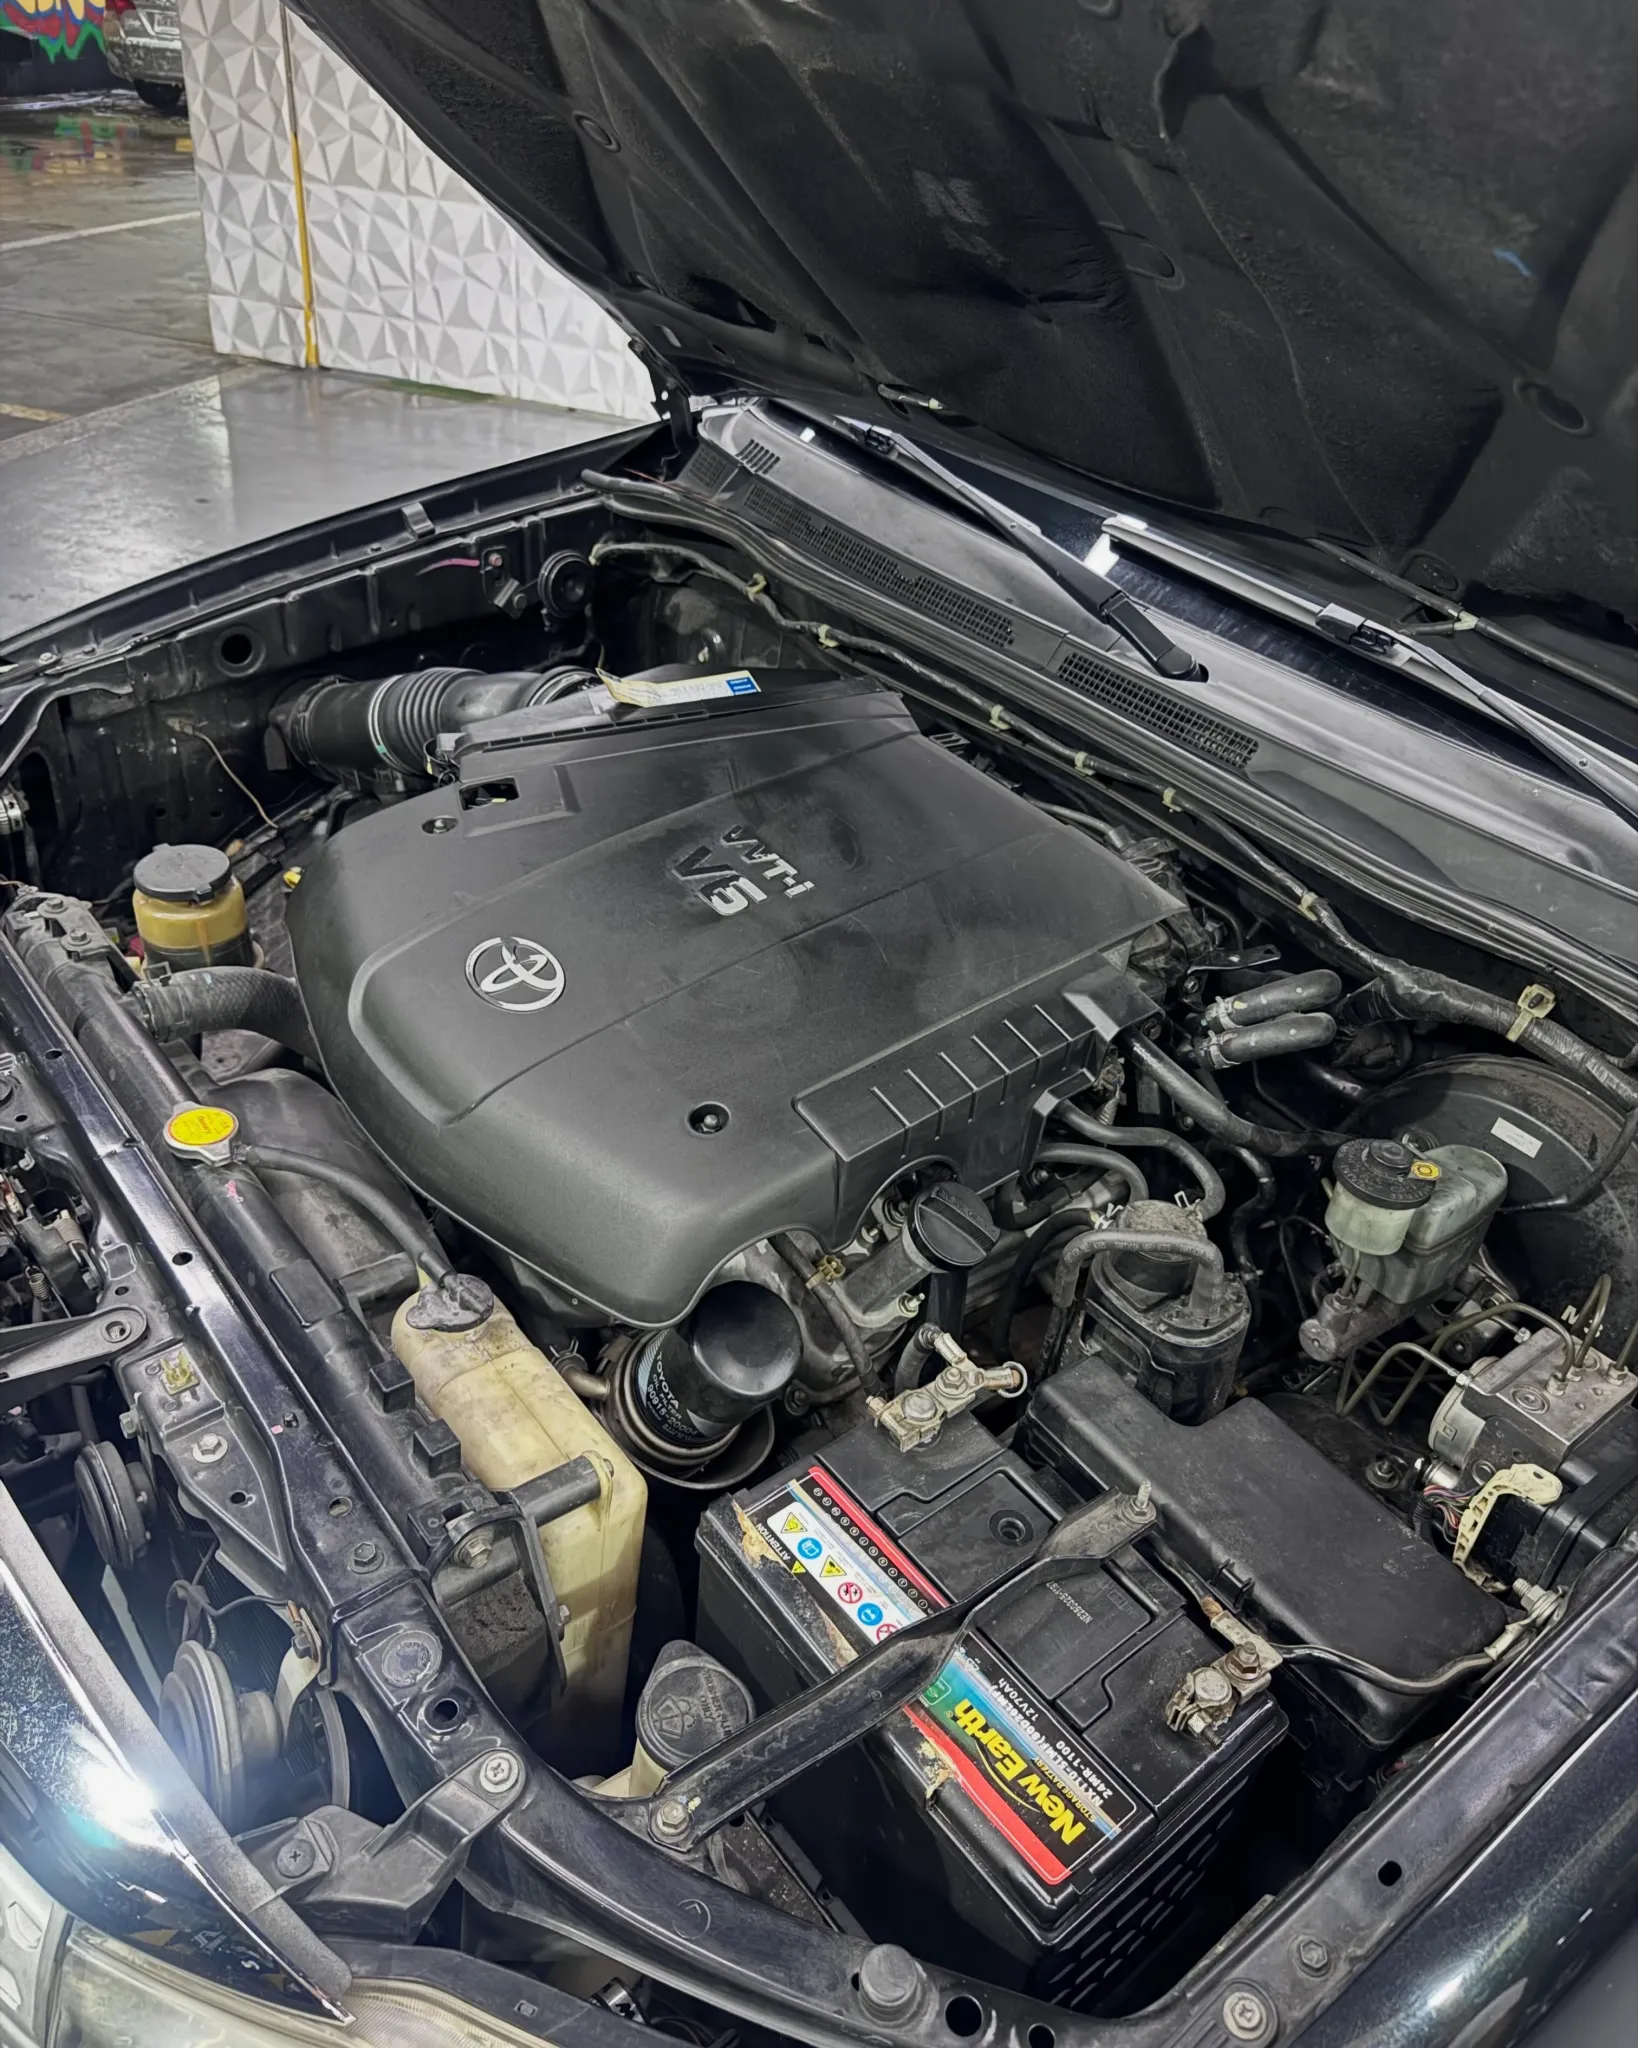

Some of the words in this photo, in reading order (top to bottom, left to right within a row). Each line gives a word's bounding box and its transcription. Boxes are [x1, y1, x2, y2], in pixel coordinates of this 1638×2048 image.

[671, 845, 767, 916] V6
[652, 1374, 660, 1390] OIL
[660, 1393, 682, 1420] FILTER
[655, 1351, 680, 1410] TOYOTA
[754, 1521, 792, 1561] ATTENTION
[996, 1676, 1040, 1722] 12V70Ah
[950, 1696, 1028, 1782] Earth
[1054, 1738, 1113, 1799] 24MR-1100
[1016, 1771, 1087, 1845] New
[1059, 1784, 1097, 1823] STORAGE
